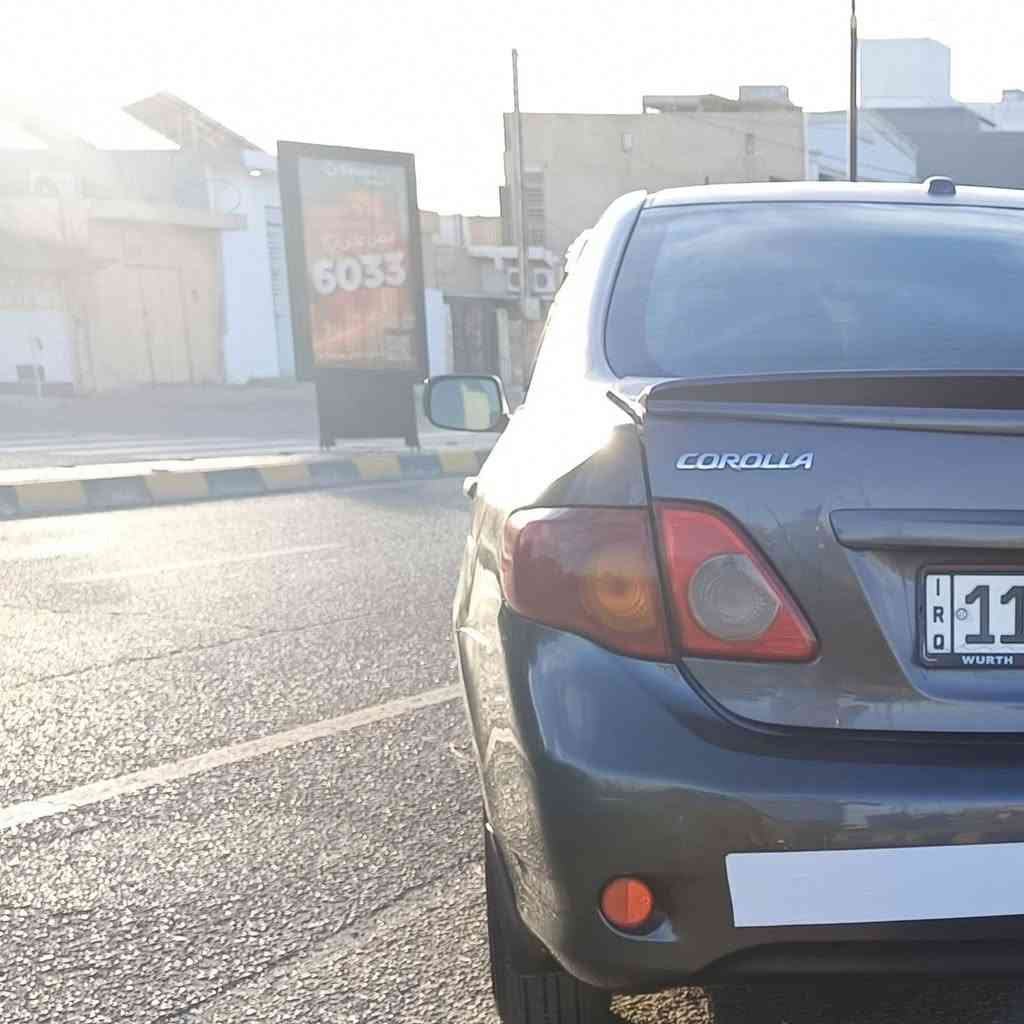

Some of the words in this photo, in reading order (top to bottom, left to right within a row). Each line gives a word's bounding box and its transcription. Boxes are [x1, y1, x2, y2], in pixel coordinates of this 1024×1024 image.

[313, 252, 406, 295] 6033
[676, 452, 814, 470] COROLLA
[961, 656, 1013, 665] WURTH
